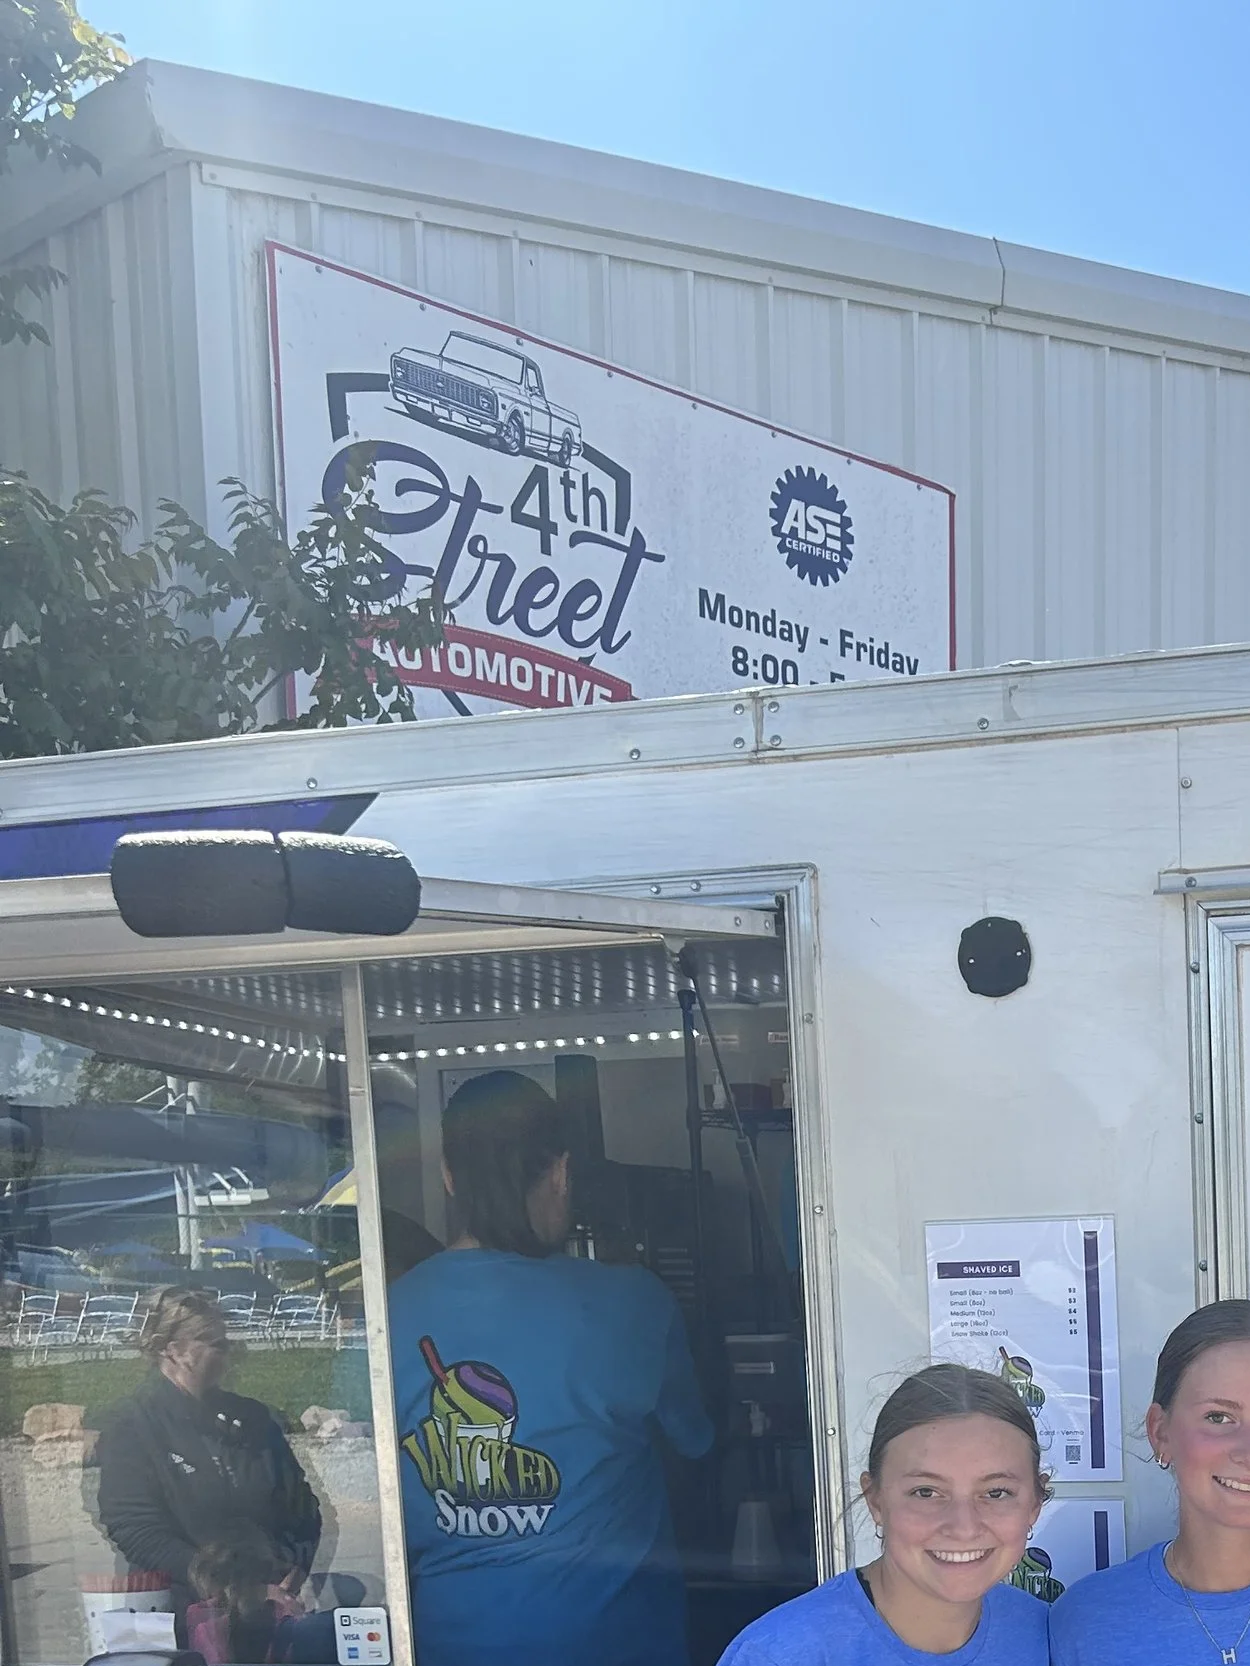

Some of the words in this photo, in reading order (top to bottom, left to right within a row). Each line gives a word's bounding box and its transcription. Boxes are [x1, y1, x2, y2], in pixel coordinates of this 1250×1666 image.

[511, 464, 608, 556] 4th
[781, 498, 841, 551] ASE
[322, 440, 665, 654] Street
[785, 538, 840, 564] CERTIFIED
[698, 587, 810, 653] Monday
[839, 628, 919, 676] Friday
[731, 645, 799, 685] 8:00
[962, 1265, 997, 1274] SHAVED
[999, 1265, 1013, 1273] ICE
[402, 1411, 561, 1501] WICKED
[342, 1633, 360, 1641] VISA
[352, 1616, 381, 1626] Square
